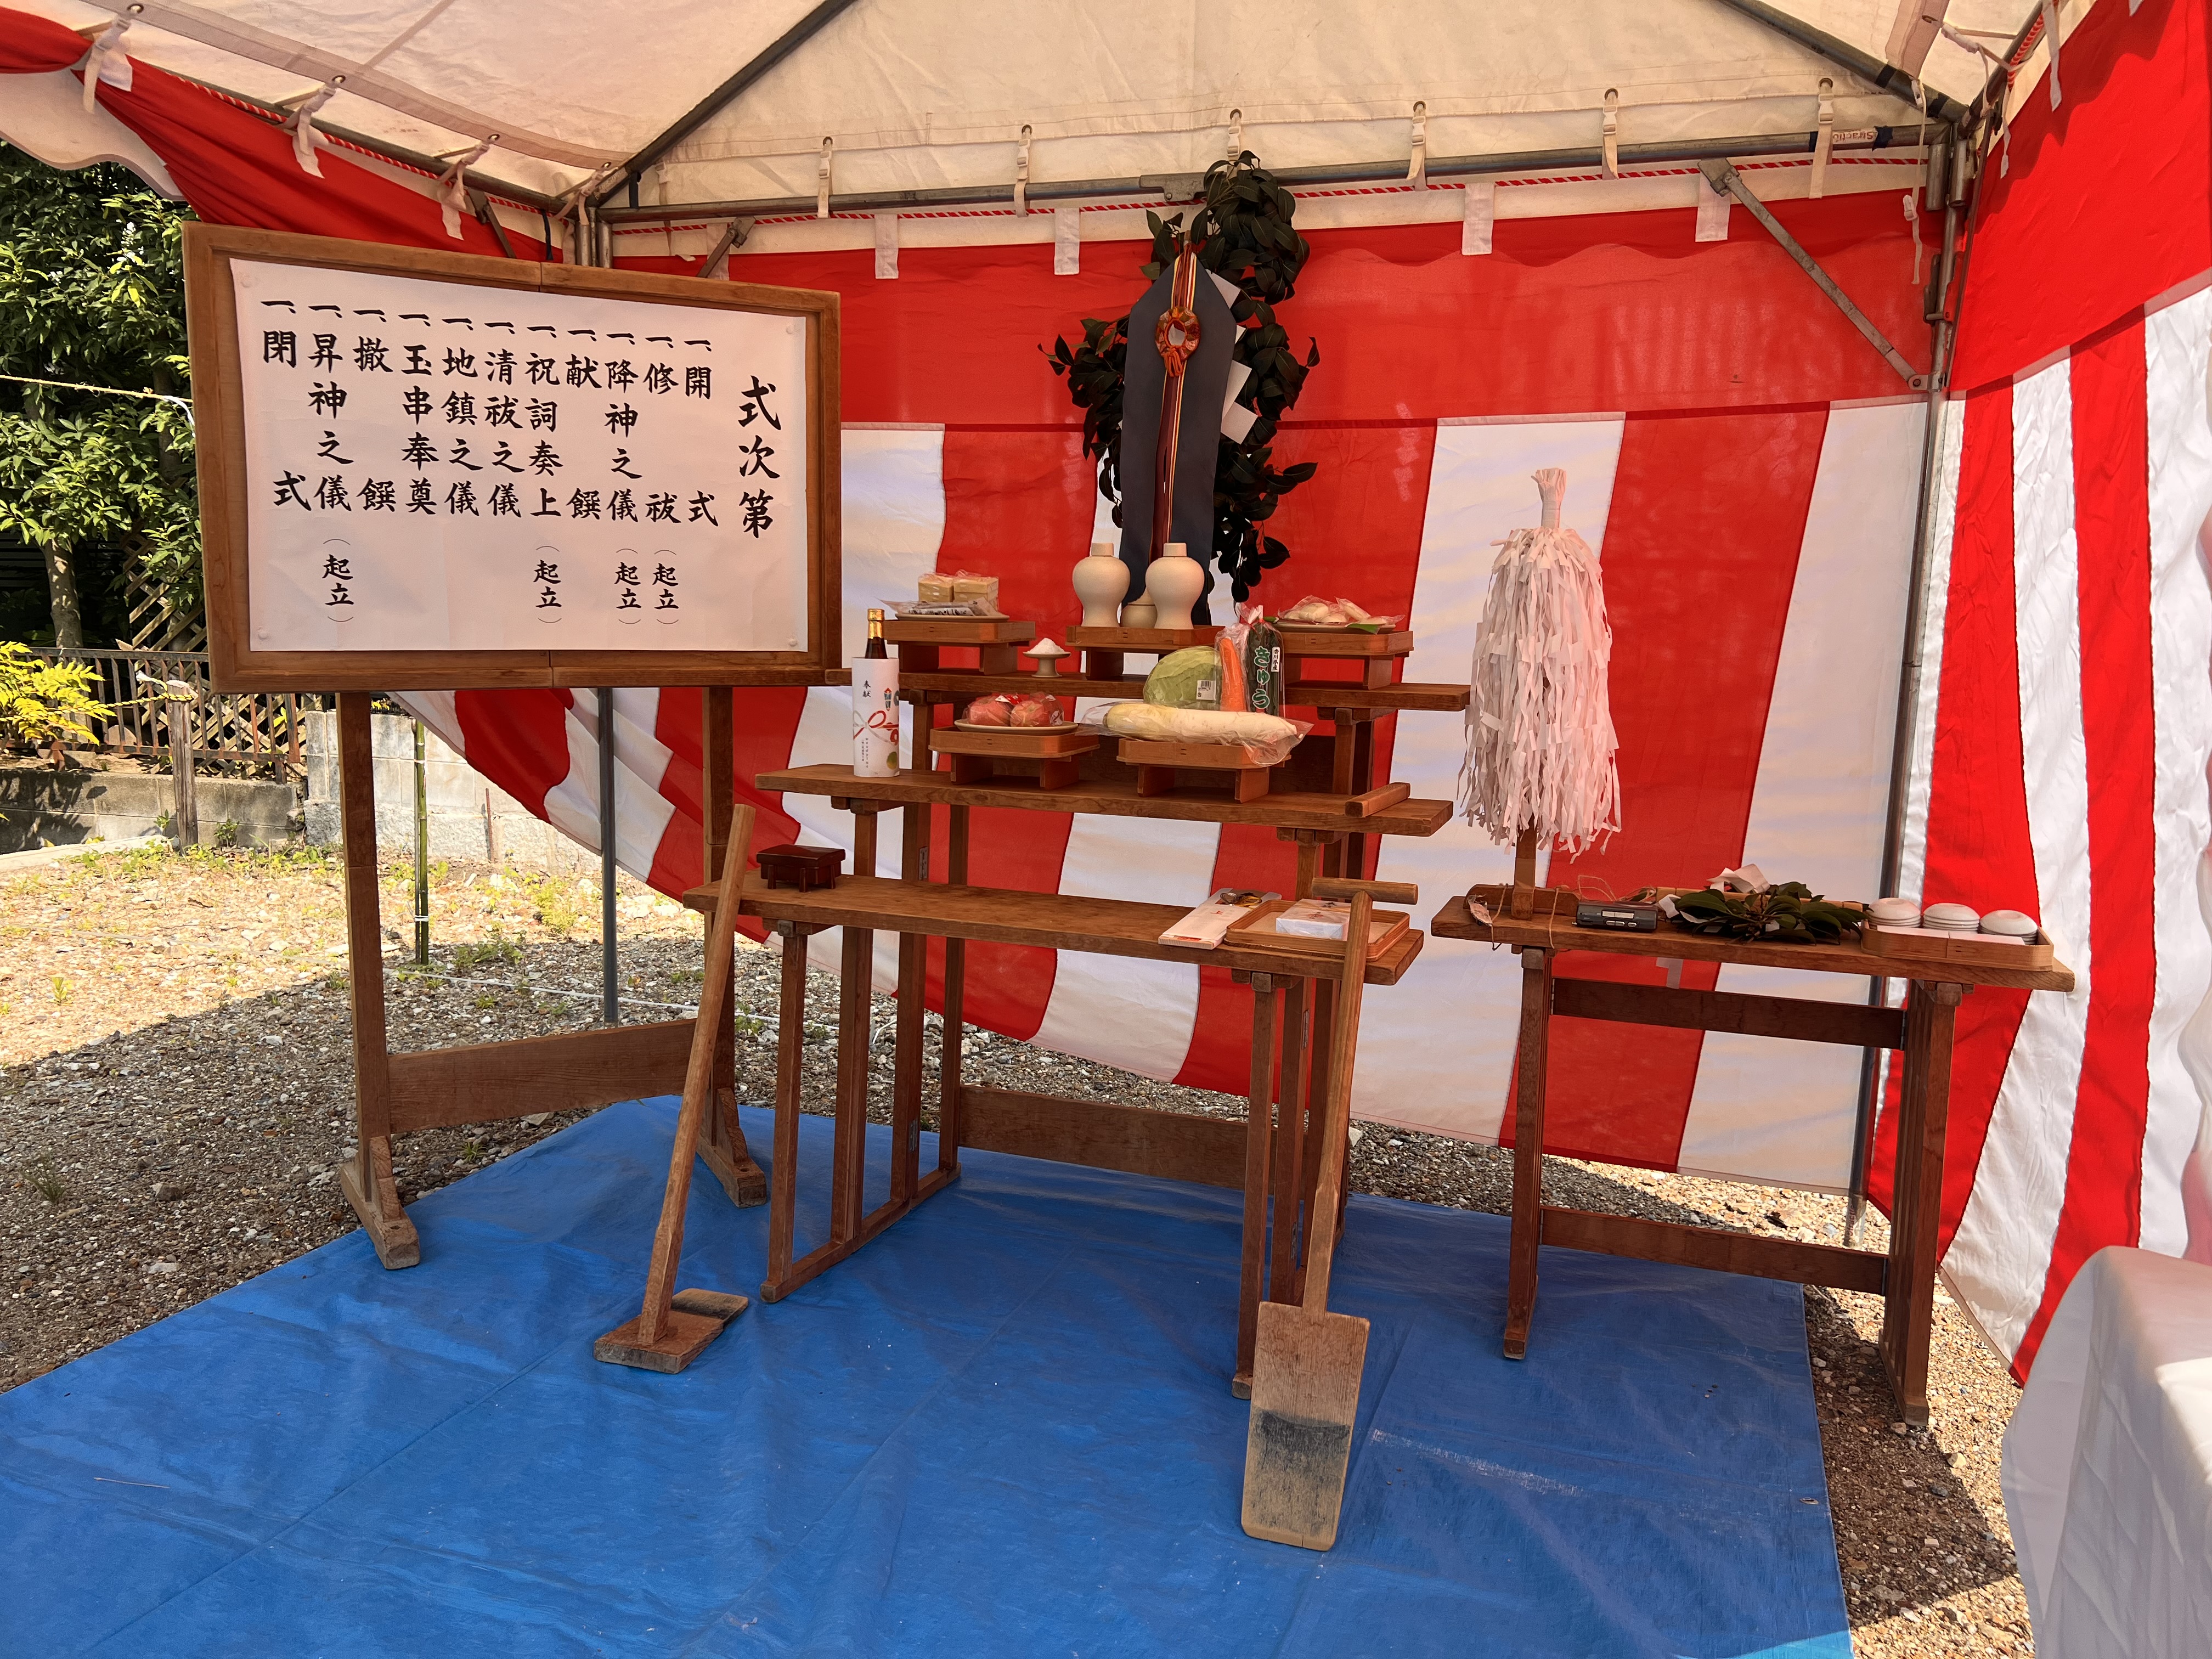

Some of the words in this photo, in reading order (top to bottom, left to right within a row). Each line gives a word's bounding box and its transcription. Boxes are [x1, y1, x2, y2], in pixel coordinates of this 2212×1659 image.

[738, 375, 781, 538] 式次第
[862, 680, 871, 698] 奉献
